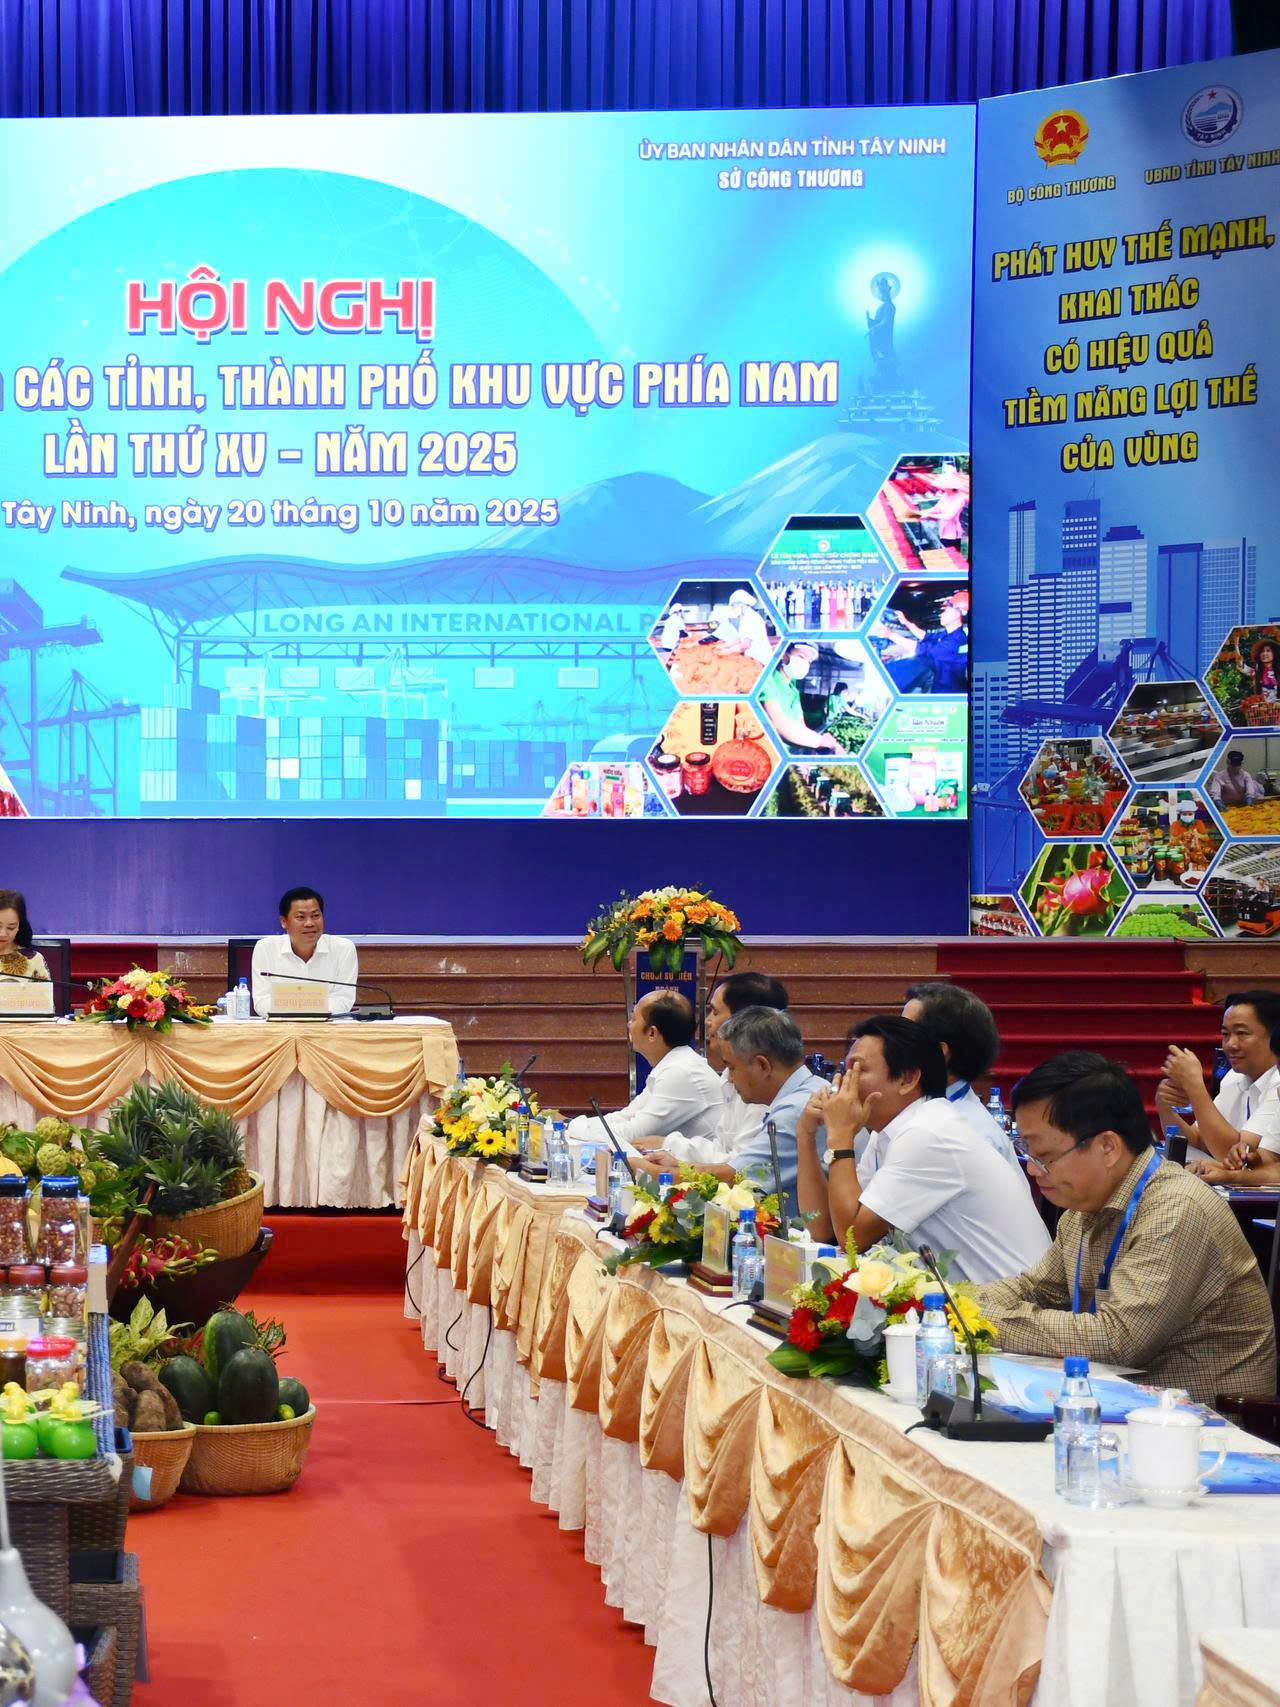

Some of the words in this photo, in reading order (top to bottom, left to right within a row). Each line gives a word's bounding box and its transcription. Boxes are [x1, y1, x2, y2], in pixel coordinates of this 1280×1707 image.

[639, 138, 664, 160] ỦY
[668, 141, 707, 160] BAN
[709, 138, 765, 159] NHÂN
[767, 138, 808, 158] DÂN
[811, 136, 856, 158] TỈNH
[858, 136, 896, 156] TÂY
[898, 137, 947, 156] NINH
[1144, 165, 1181, 185] UBND
[1184, 158, 1216, 179] TỈNH
[1219, 153, 1245, 174] TÂY
[1247, 149, 1280, 169] NINH
[718, 167, 742, 190] SỞ
[746, 168, 793, 189] CÔNG
[797, 167, 864, 188] THƯƠNG
[1007, 186, 1025, 206] BỘ
[1028, 182, 1062, 202] CÔNG
[1065, 176, 1117, 198] THƯƠNG
[992, 241, 1056, 282] PHÁT
[1064, 236, 1118, 273] HUY
[1123, 218, 1173, 265] THẾ
[1179, 215, 1276, 260] MẠNH,
[125, 264, 249, 344] HỘI
[264, 278, 436, 344] NGHỊ
[1058, 286, 1122, 324] KHAI
[1130, 274, 1200, 317] THÁC
[1044, 337, 1080, 376] CÓ
[1087, 332, 1150, 373] HIỆU
[1157, 321, 1214, 361] QUẢ
[14, 357, 94, 411] CÁC
[103, 353, 207, 413] TỈNH,
[217, 356, 346, 411] THÀNH
[358, 349, 438, 410] PHỐ
[449, 362, 532, 409] KHU
[543, 360, 625, 417] VỰC
[633, 353, 732, 408] PHÍA
[739, 360, 840, 407] NAM
[1003, 386, 1067, 429] TIỀM
[1074, 384, 1148, 423] NĂNG
[1154, 378, 1199, 420] LỢI
[1205, 363, 1258, 409] THẾ
[43, 418, 118, 478] LẦN
[128, 424, 208, 478] THỨ
[215, 432, 268, 477] XV
[315, 424, 409, 477] NĂM
[418, 431, 518, 477] 2025
[1061, 433, 1114, 473] CỦA
[1124, 429, 1199, 468] VÙNG
[1, 499, 56, 533] Tây
[61, 499, 138, 533] Ninh,
[144, 497, 222, 534] ngày
[227, 499, 265, 527] 20
[271, 496, 360, 534] tháng
[368, 499, 405, 527] 10
[411, 497, 479, 527] năm
[485, 498, 560, 527] 2025
[263, 613, 346, 633] LONG
[351, 612, 394, 633] AN
[401, 611, 624, 633] INTERNATIONAL
